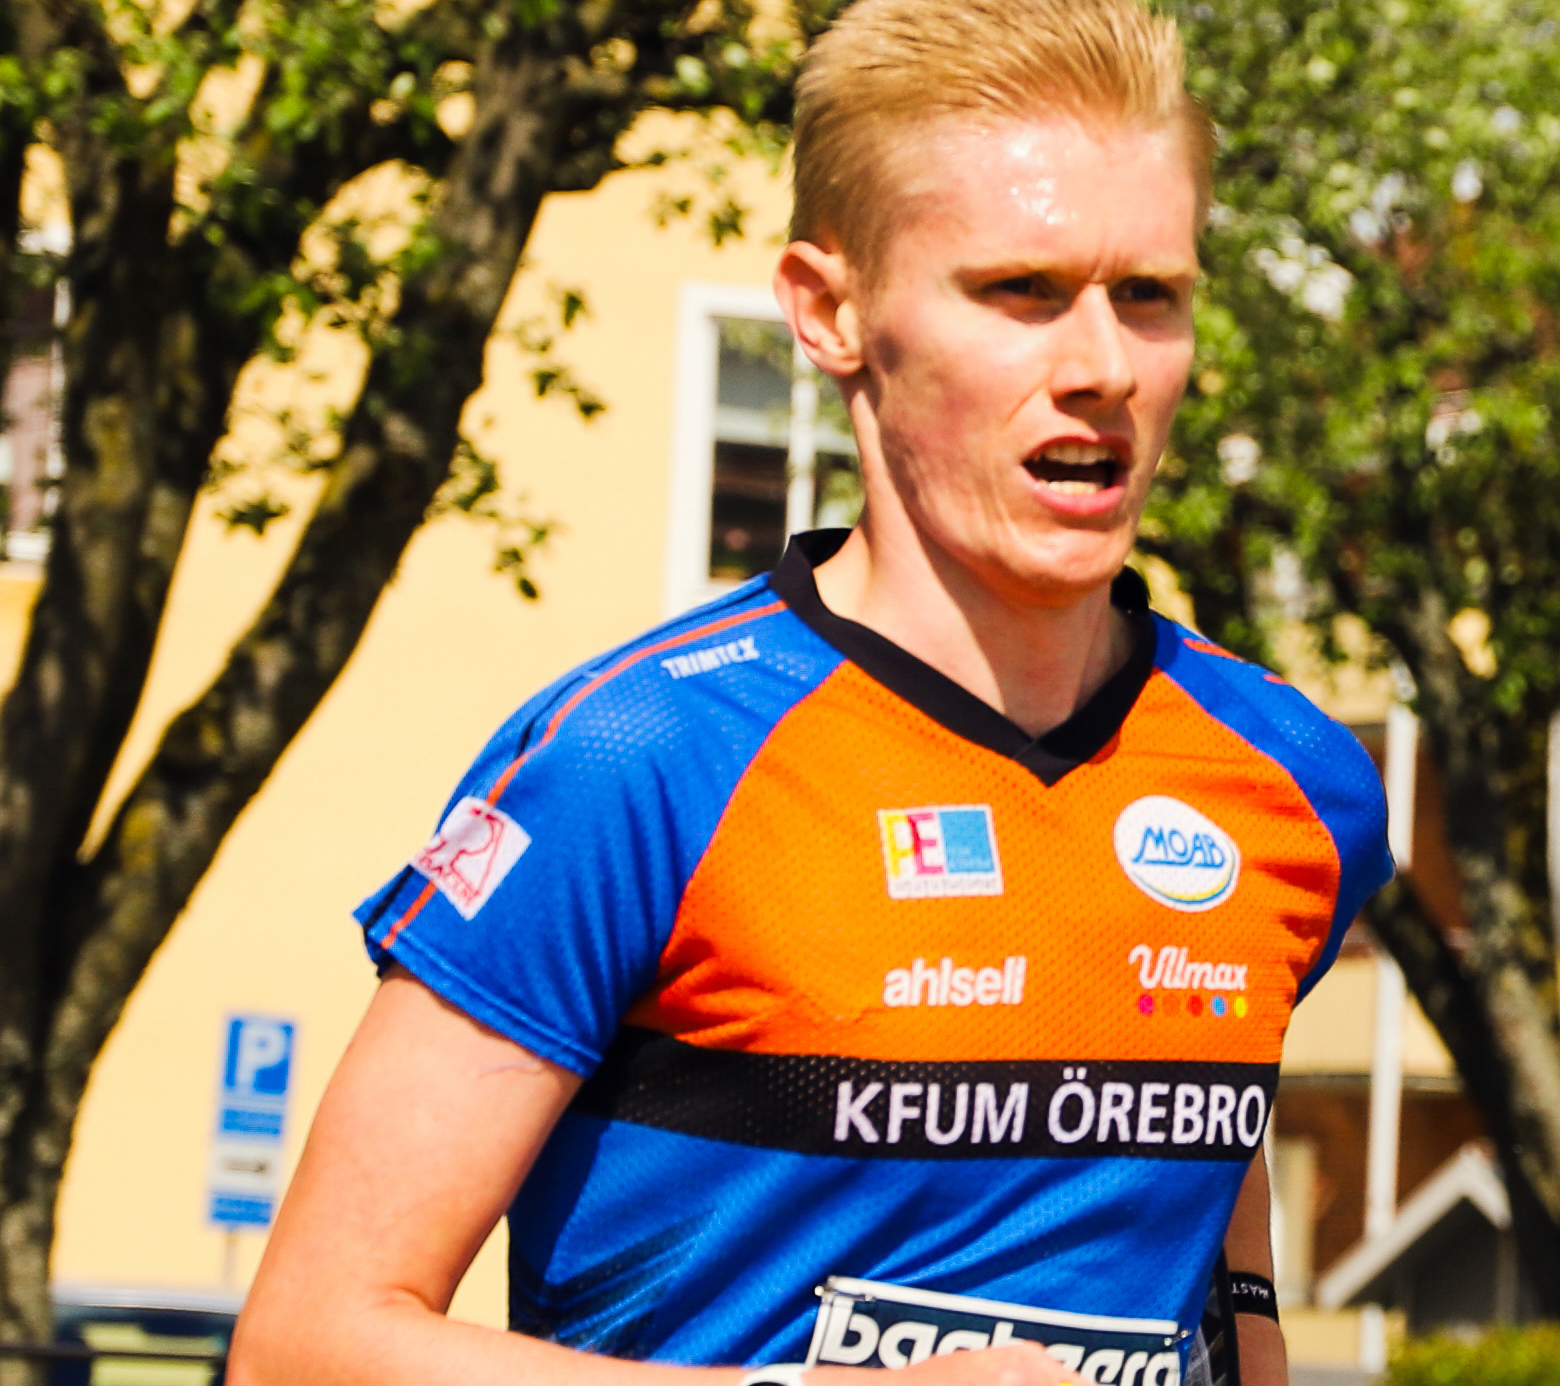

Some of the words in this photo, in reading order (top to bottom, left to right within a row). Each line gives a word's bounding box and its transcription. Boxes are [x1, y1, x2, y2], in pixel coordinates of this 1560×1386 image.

[884, 955, 1027, 1007] ahlsell
[1128, 944, 1248, 990] Ullmax
[239, 1021, 286, 1087] P
[834, 1081, 1029, 1145] KFUM
[1048, 1066, 1267, 1148] ÖREBRO
